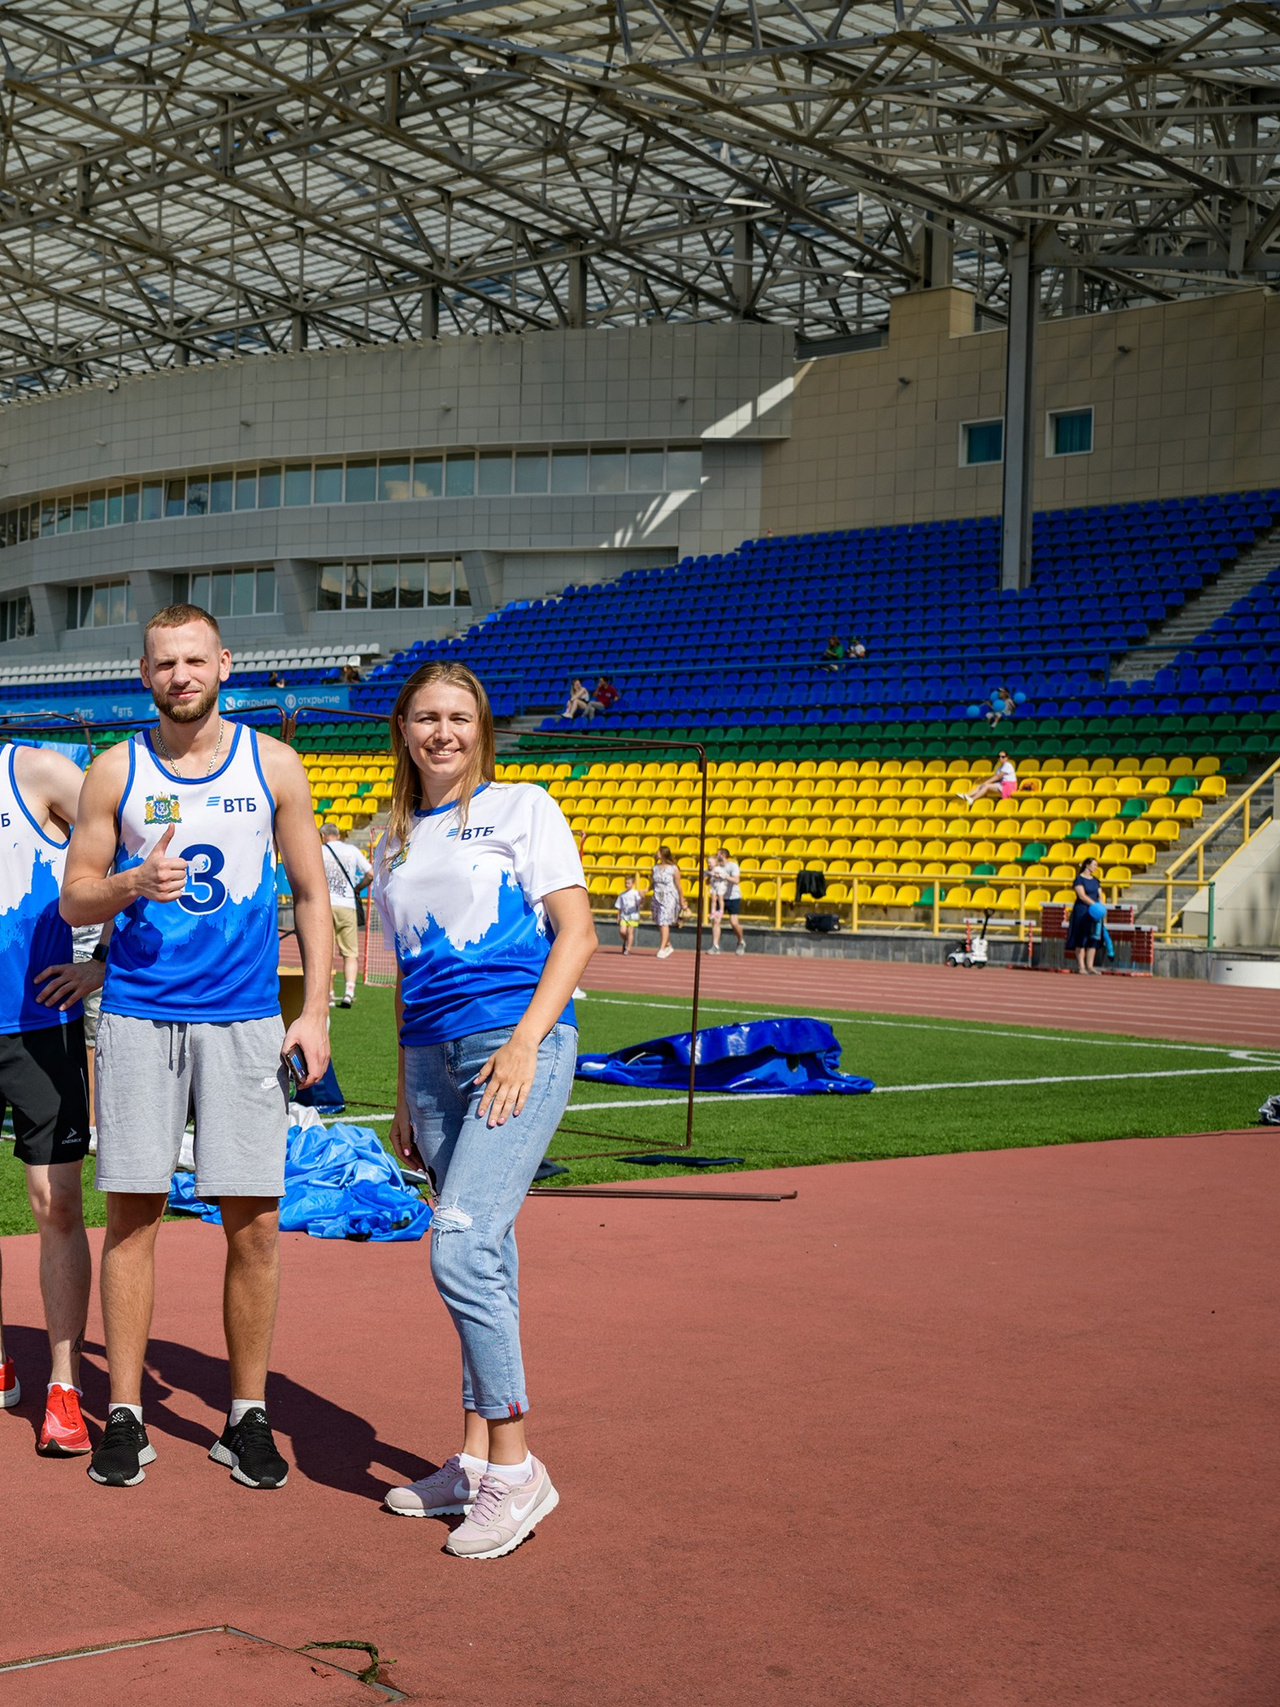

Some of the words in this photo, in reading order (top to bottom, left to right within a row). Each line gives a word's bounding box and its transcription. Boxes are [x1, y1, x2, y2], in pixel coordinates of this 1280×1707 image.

[298, 695, 340, 707] открытие
[224, 798, 257, 813] ВТБ
[461, 826, 495, 841] ВТБ
[176, 843, 227, 916] 3
